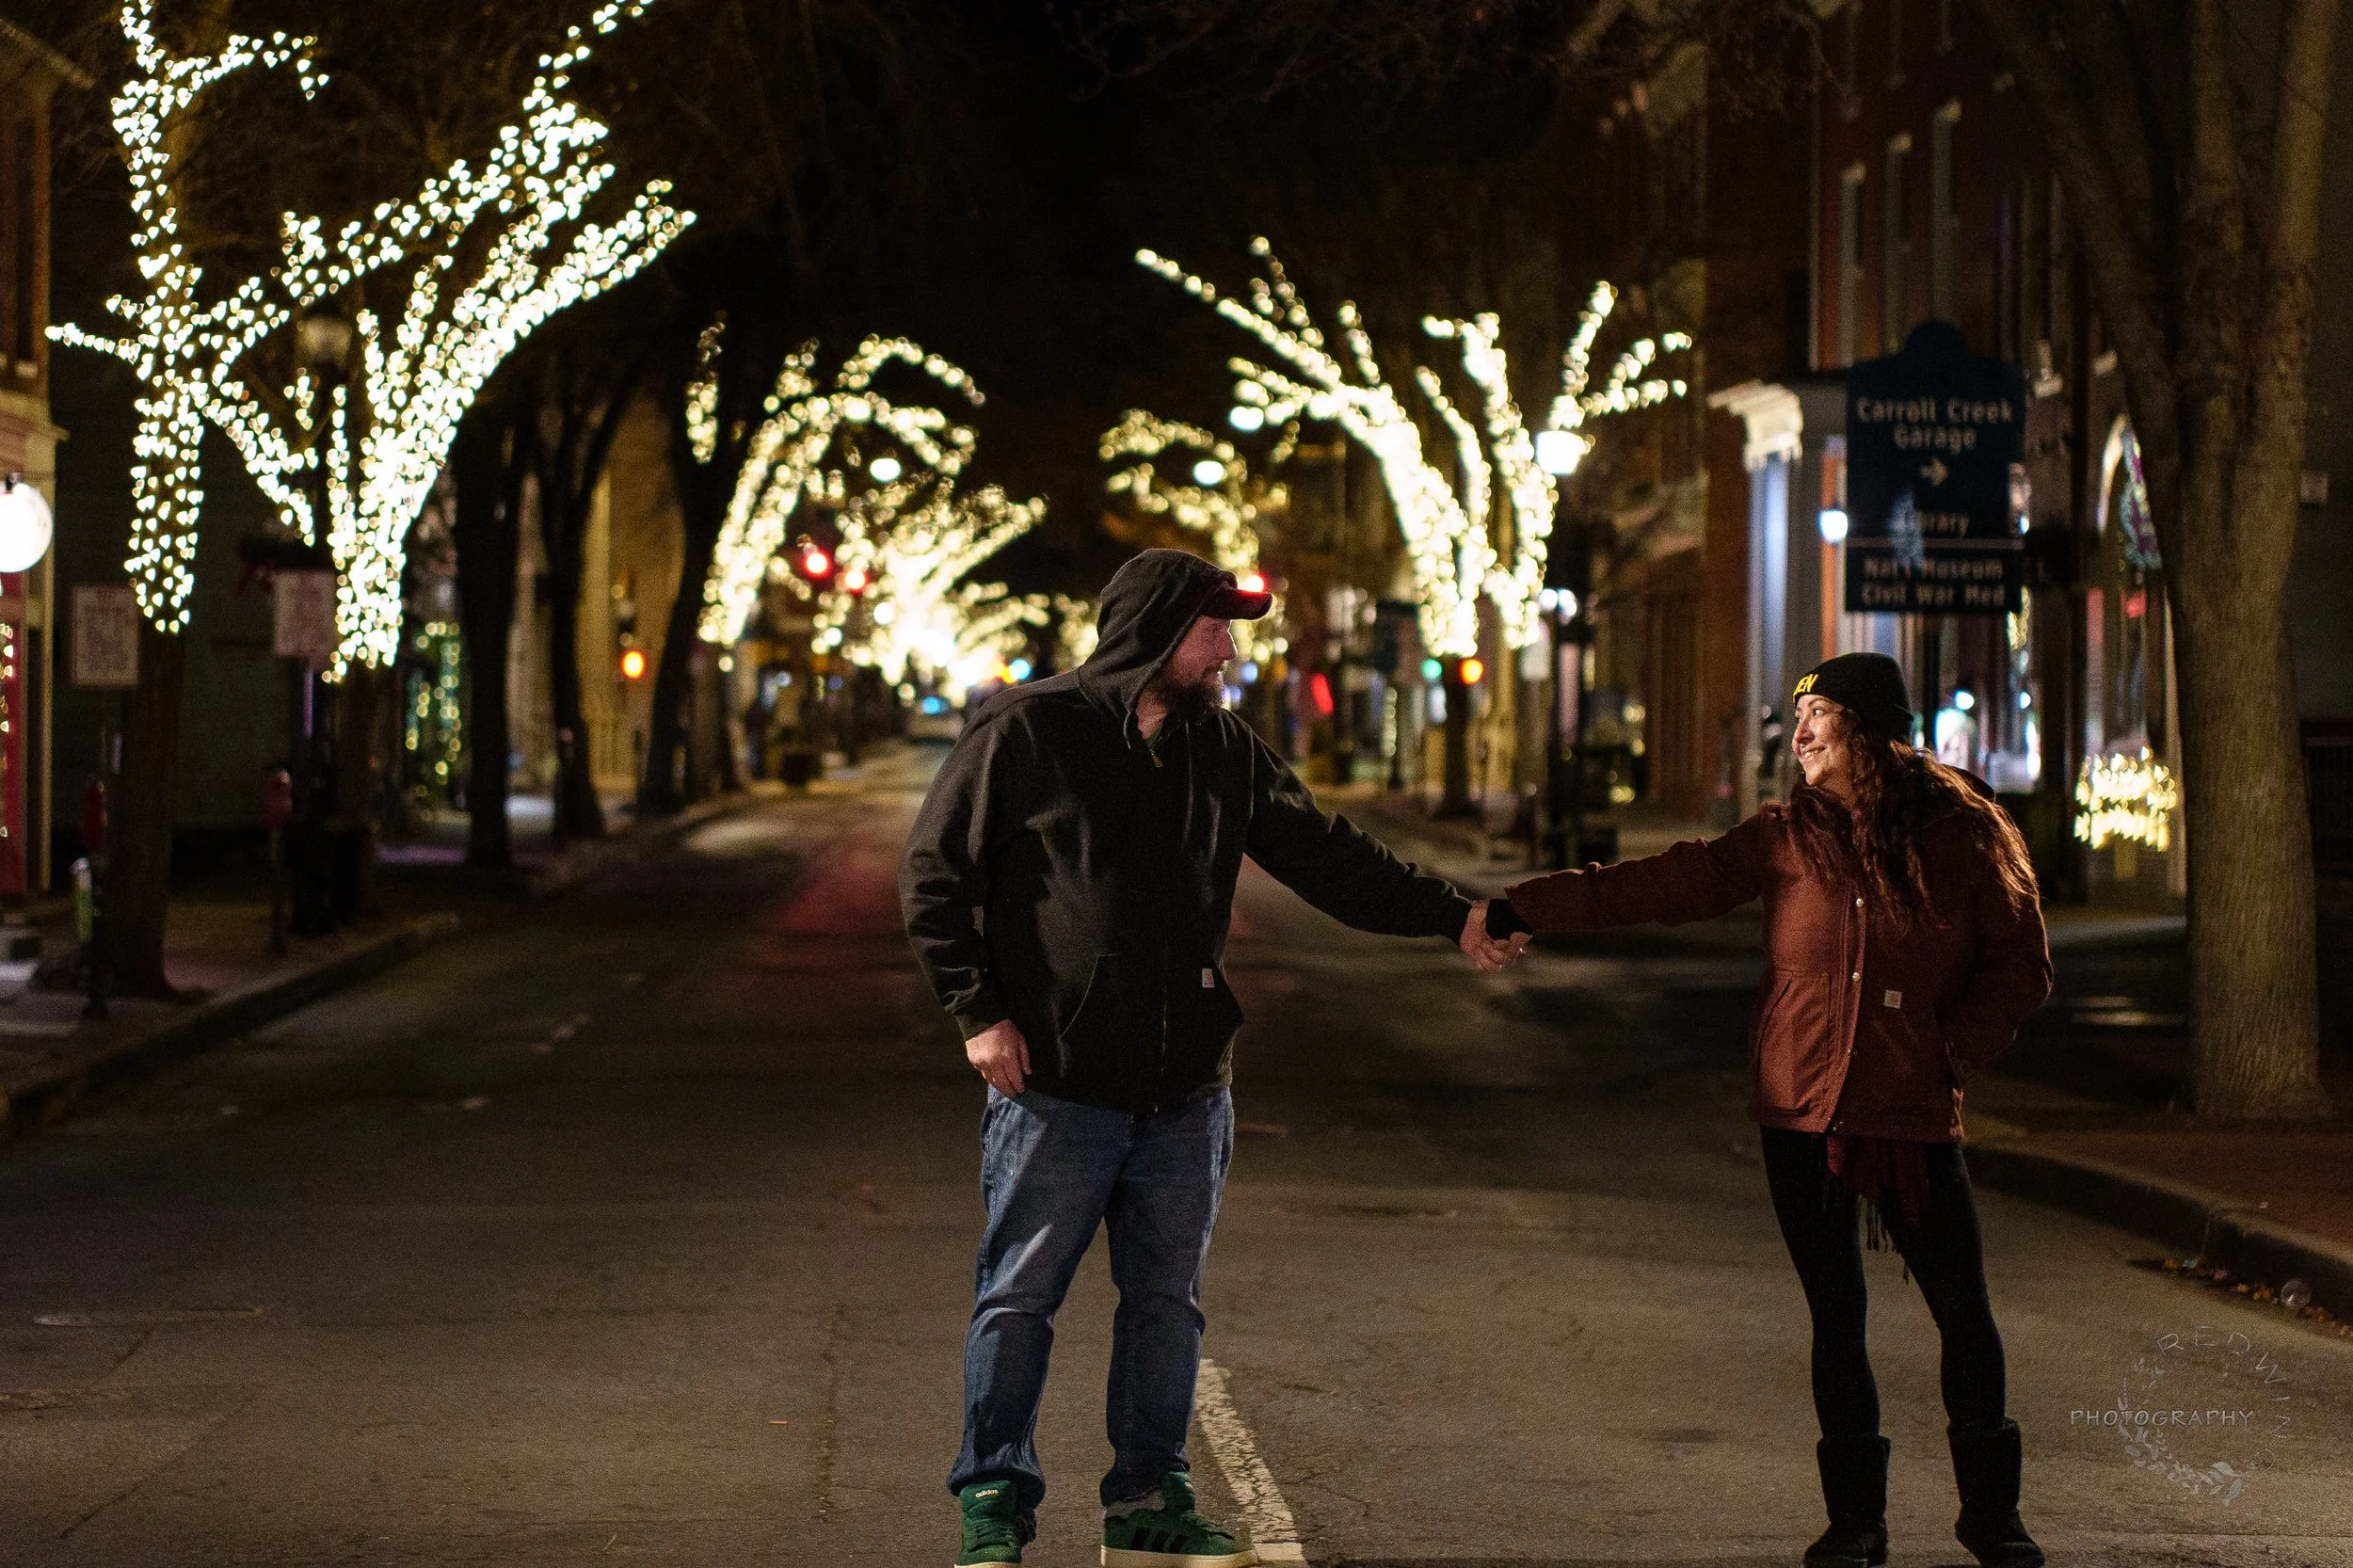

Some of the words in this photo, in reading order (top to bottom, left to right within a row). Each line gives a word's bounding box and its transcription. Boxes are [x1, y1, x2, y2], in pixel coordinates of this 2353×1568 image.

[1856, 395, 1937, 424] Carroll
[1946, 397, 2014, 424] Creek
[1894, 424, 1978, 455] Garage
[1862, 580, 1907, 606] Civil
[1915, 581, 1957, 606] War
[1964, 582, 2007, 606] Med
